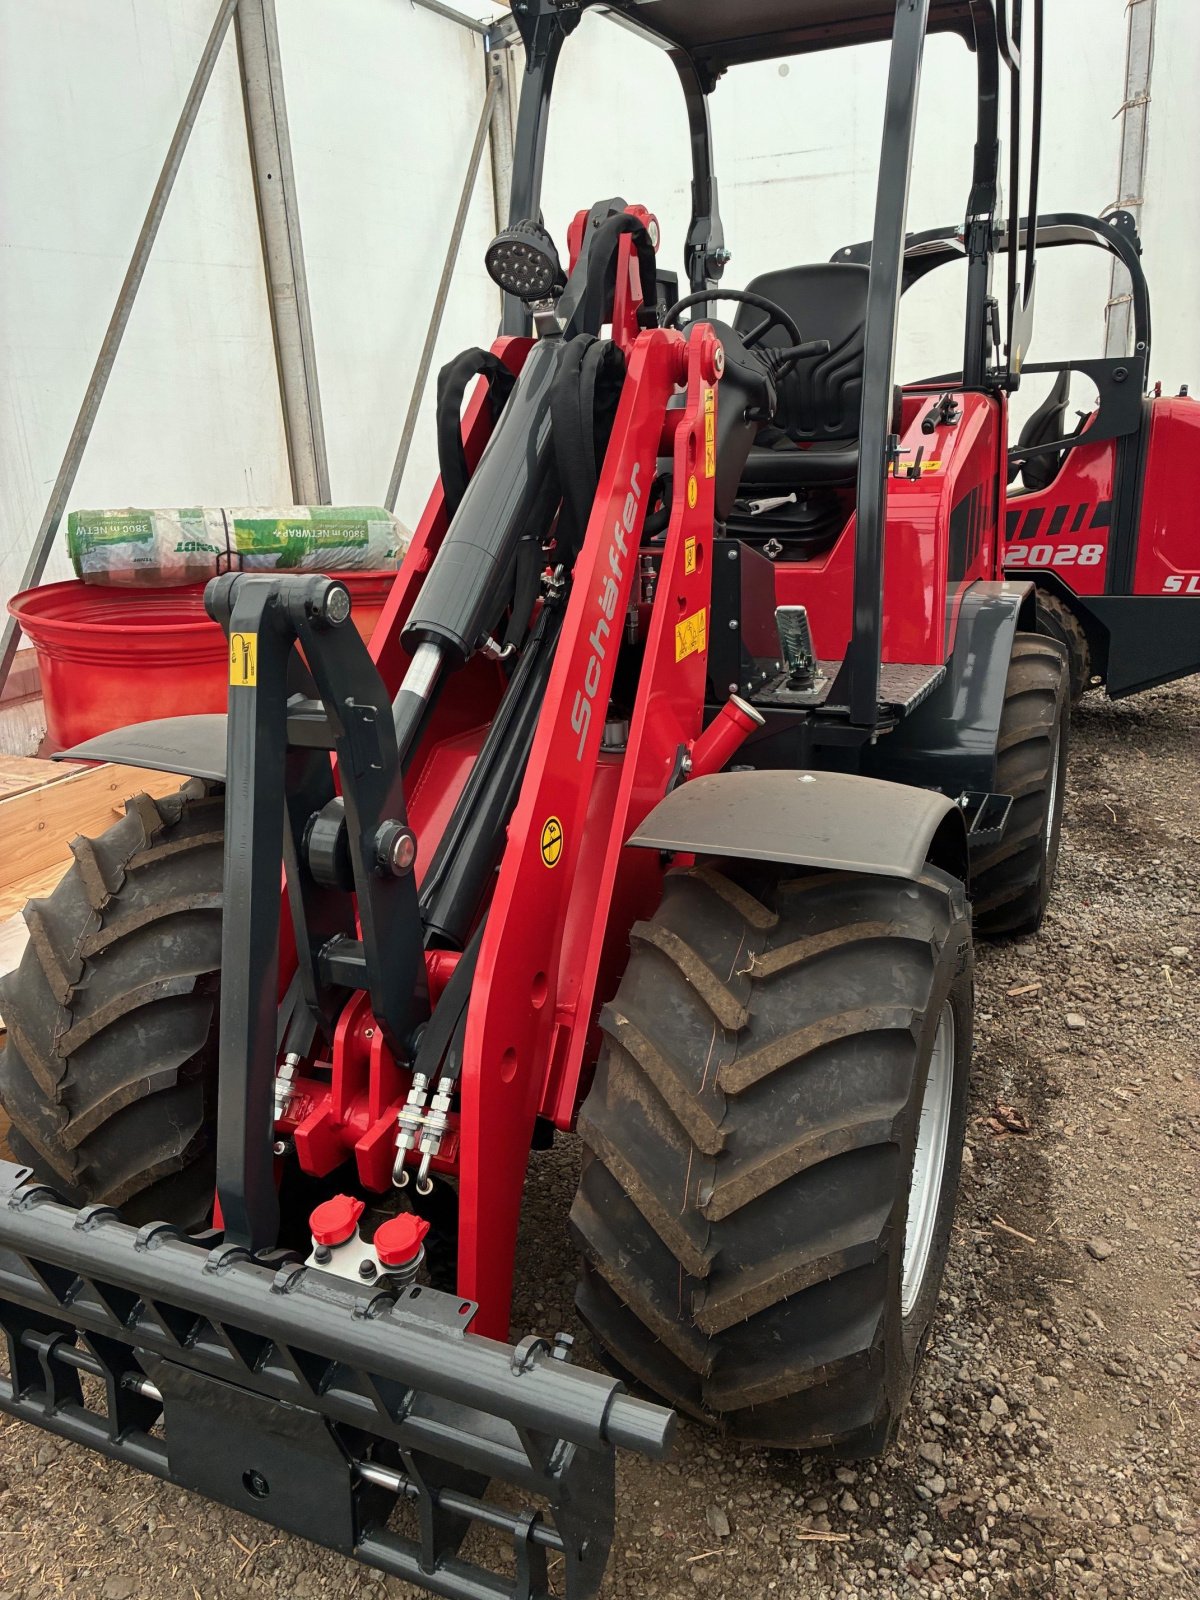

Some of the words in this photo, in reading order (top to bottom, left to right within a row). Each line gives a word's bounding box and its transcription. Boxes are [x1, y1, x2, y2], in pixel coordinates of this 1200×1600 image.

[342, 530, 366, 538] 3800
[1003, 544, 1104, 566] 2028
[570, 462, 640, 761] Schäffer
